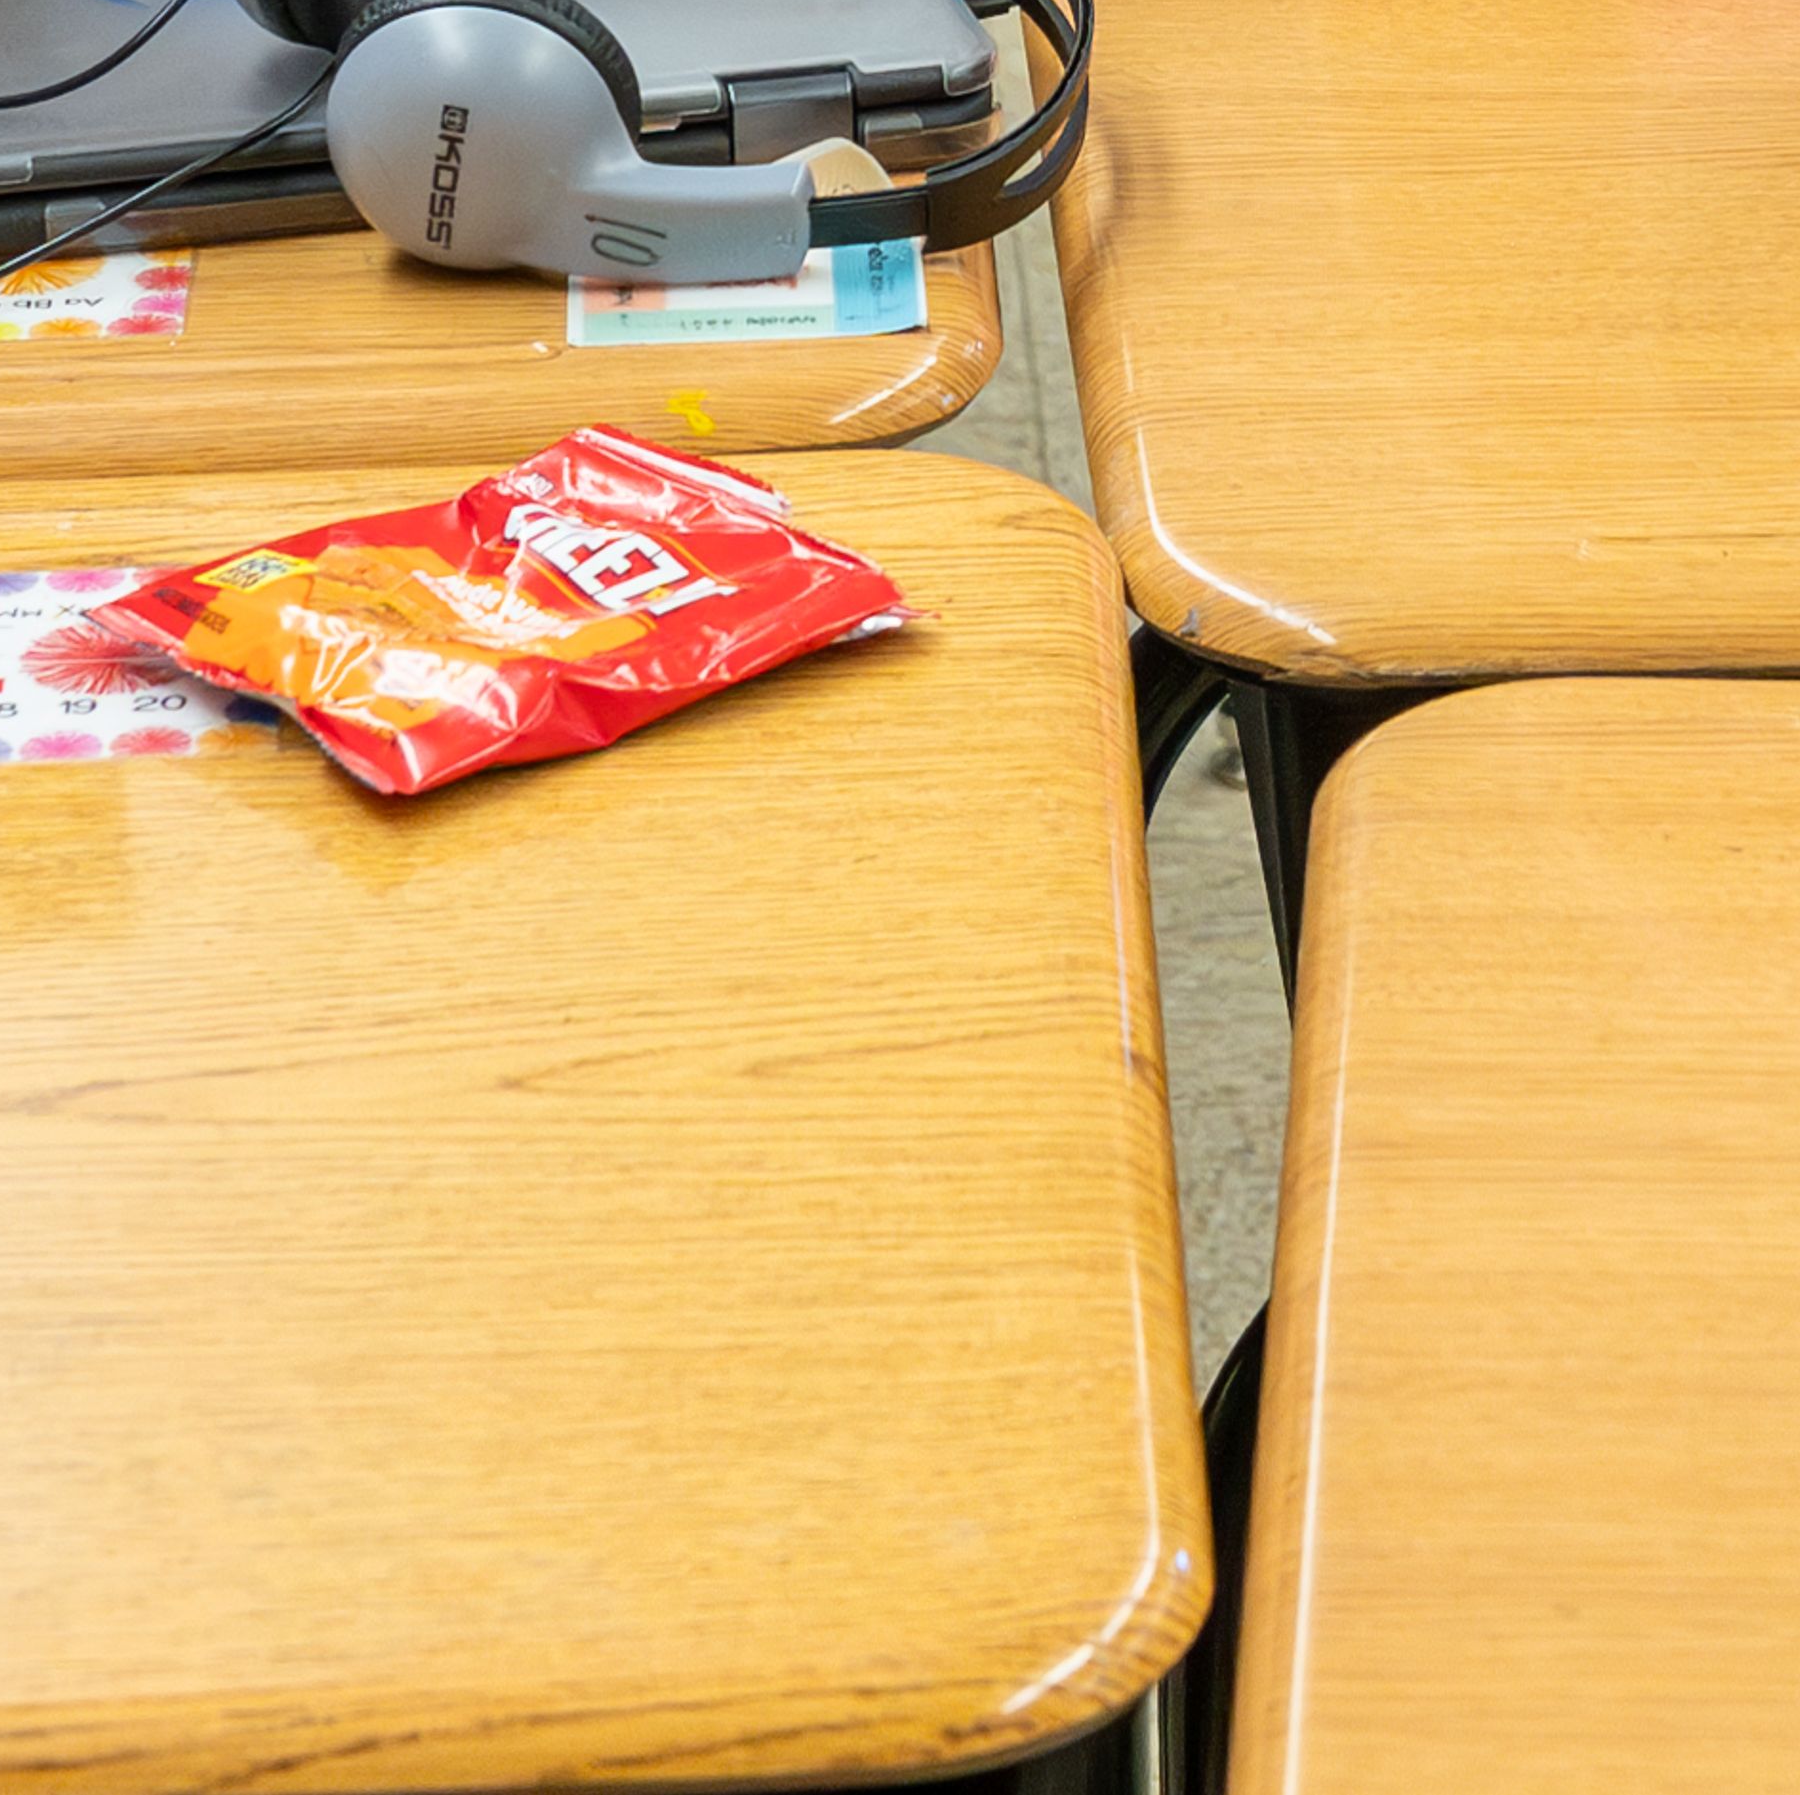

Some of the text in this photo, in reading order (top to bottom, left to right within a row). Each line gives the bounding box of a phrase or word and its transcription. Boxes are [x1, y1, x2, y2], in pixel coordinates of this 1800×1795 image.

[427, 135, 467, 251] KOSS
[61, 699, 96, 715] 19
[133, 694, 187, 712] 20
